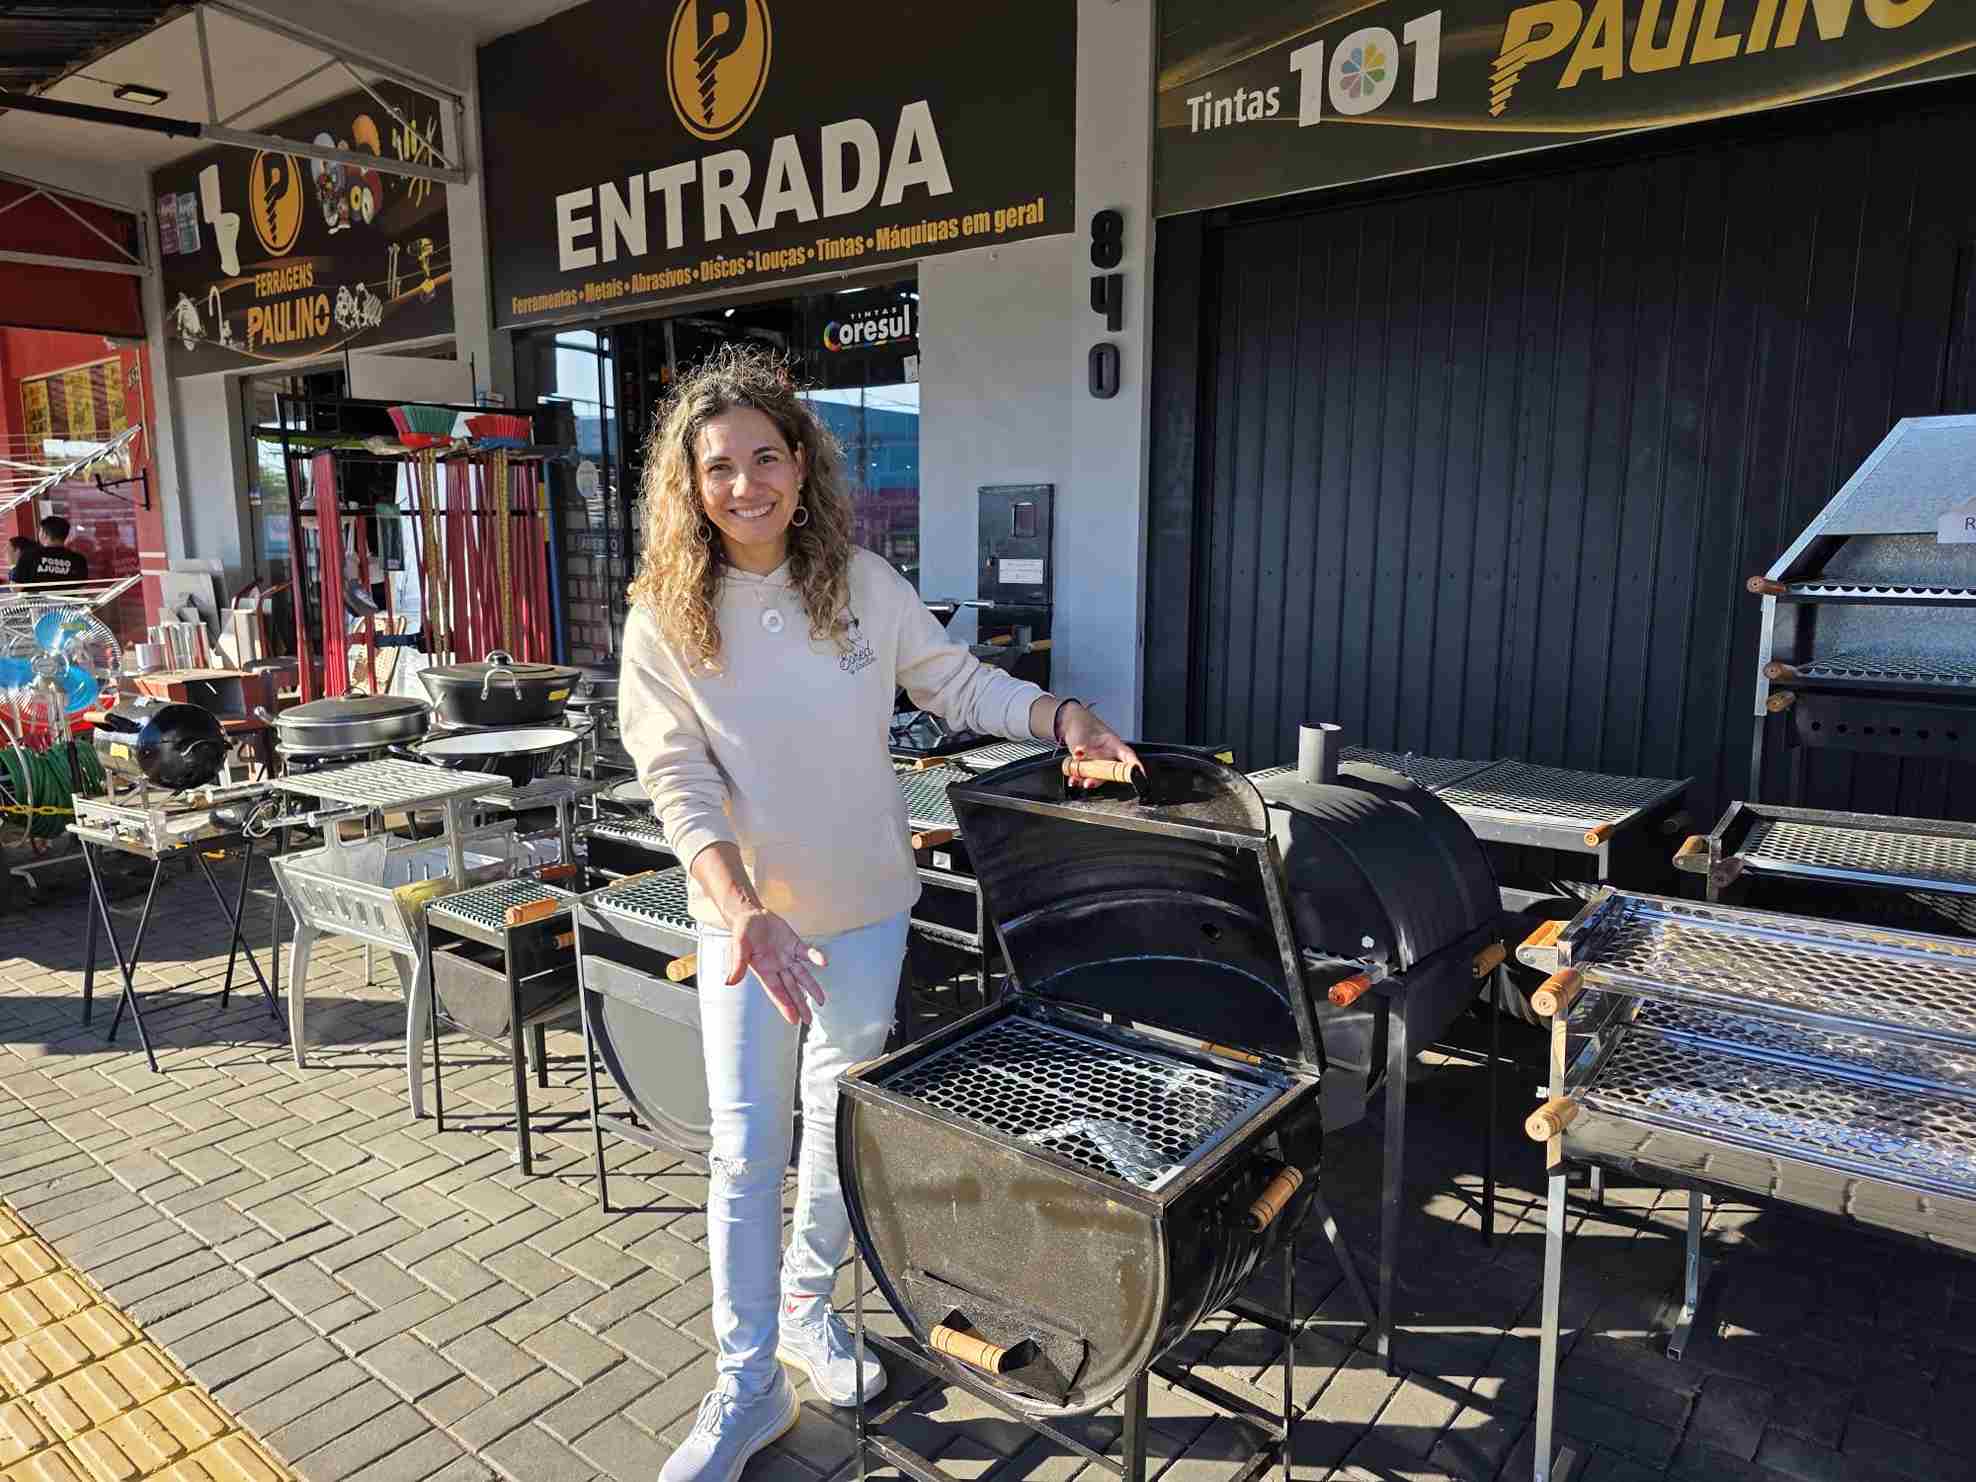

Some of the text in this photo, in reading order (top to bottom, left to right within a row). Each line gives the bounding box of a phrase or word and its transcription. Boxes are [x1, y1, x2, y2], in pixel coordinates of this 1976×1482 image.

[1187, 9, 1442, 133] Tintas 101
[1488, 0, 1936, 118] PAULI
[555, 99, 953, 272] ENTRADA
[255, 263, 313, 298] FERRAGENS
[512, 197, 1045, 314] Ferramentas Metais Abrasivos Discos Louças Tintas Máquinas em geral
[247, 293, 330, 352] PAULINO
[823, 303, 911, 352] Coresul
[850, 306, 897, 320] TINTAS
[1088, 209, 1124, 400] 840
[41, 557, 71, 568] POSSO
